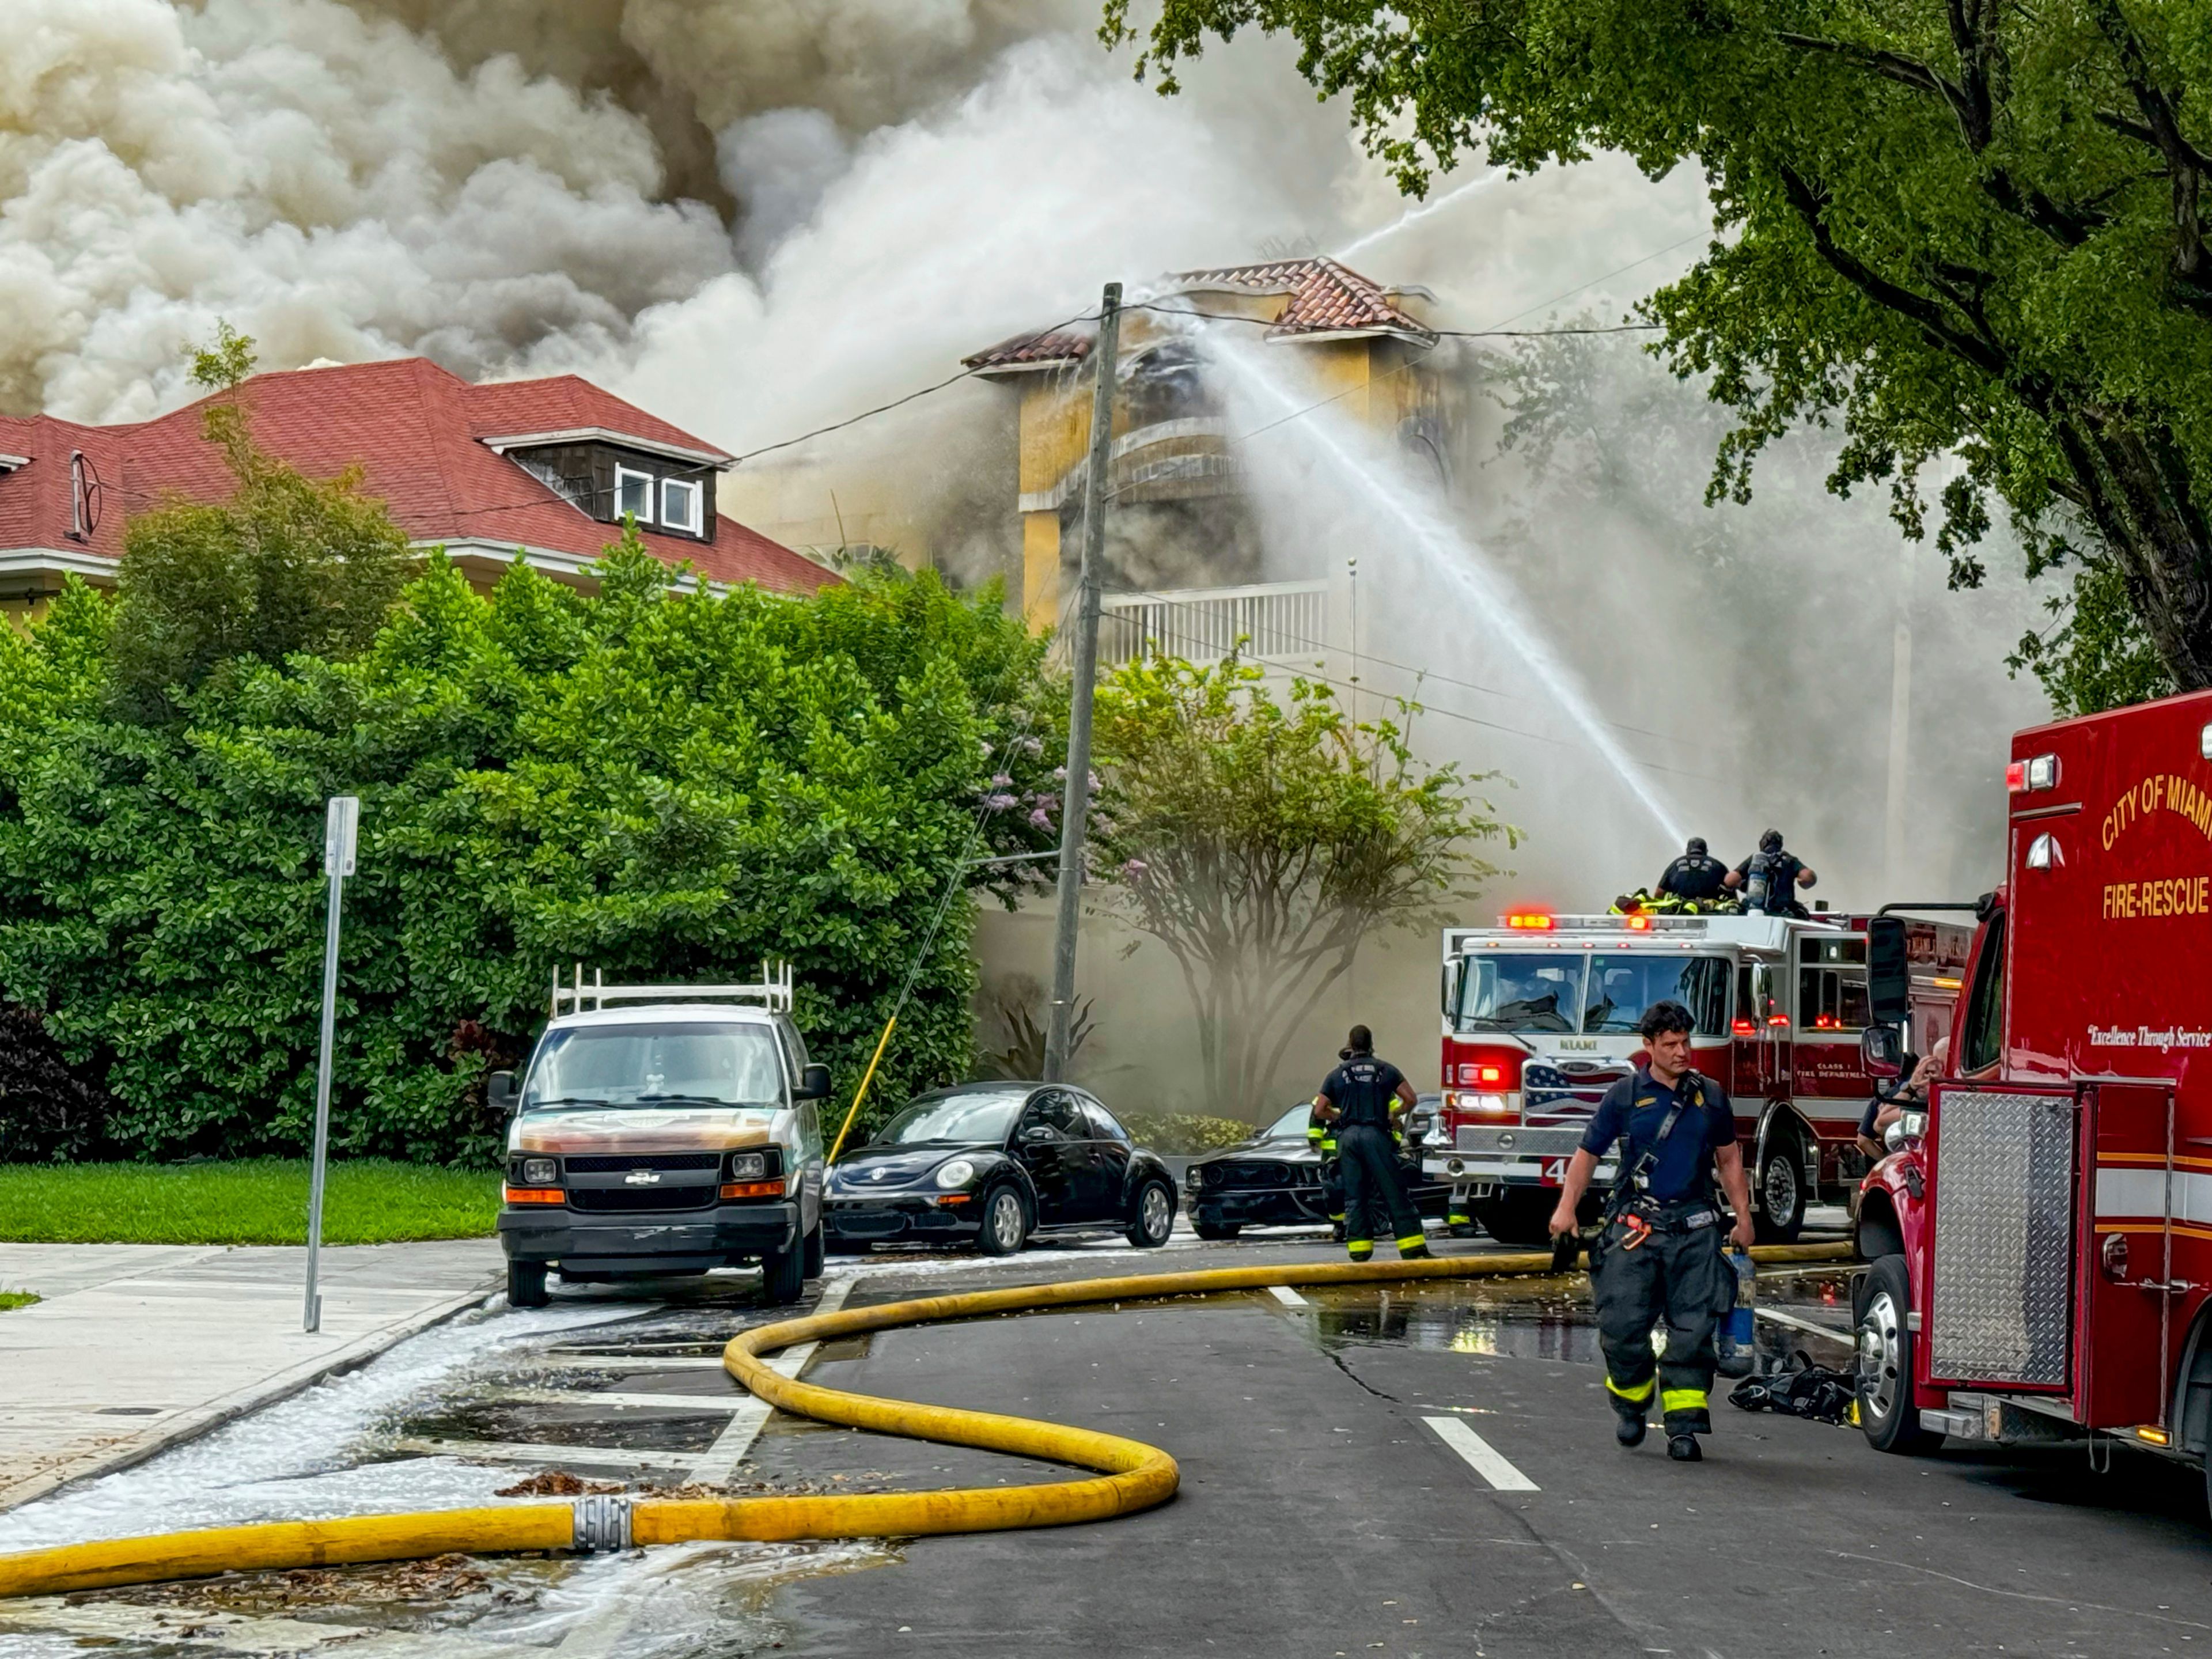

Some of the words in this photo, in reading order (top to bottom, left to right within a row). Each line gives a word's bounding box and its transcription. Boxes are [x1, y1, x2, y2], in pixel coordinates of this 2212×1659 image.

[2103, 785, 2138, 851] CITY
[2141, 774, 2164, 814] OF
[2103, 877, 2209, 919] FIRE-RESCUE
[2137, 1025, 2175, 1054] Through
